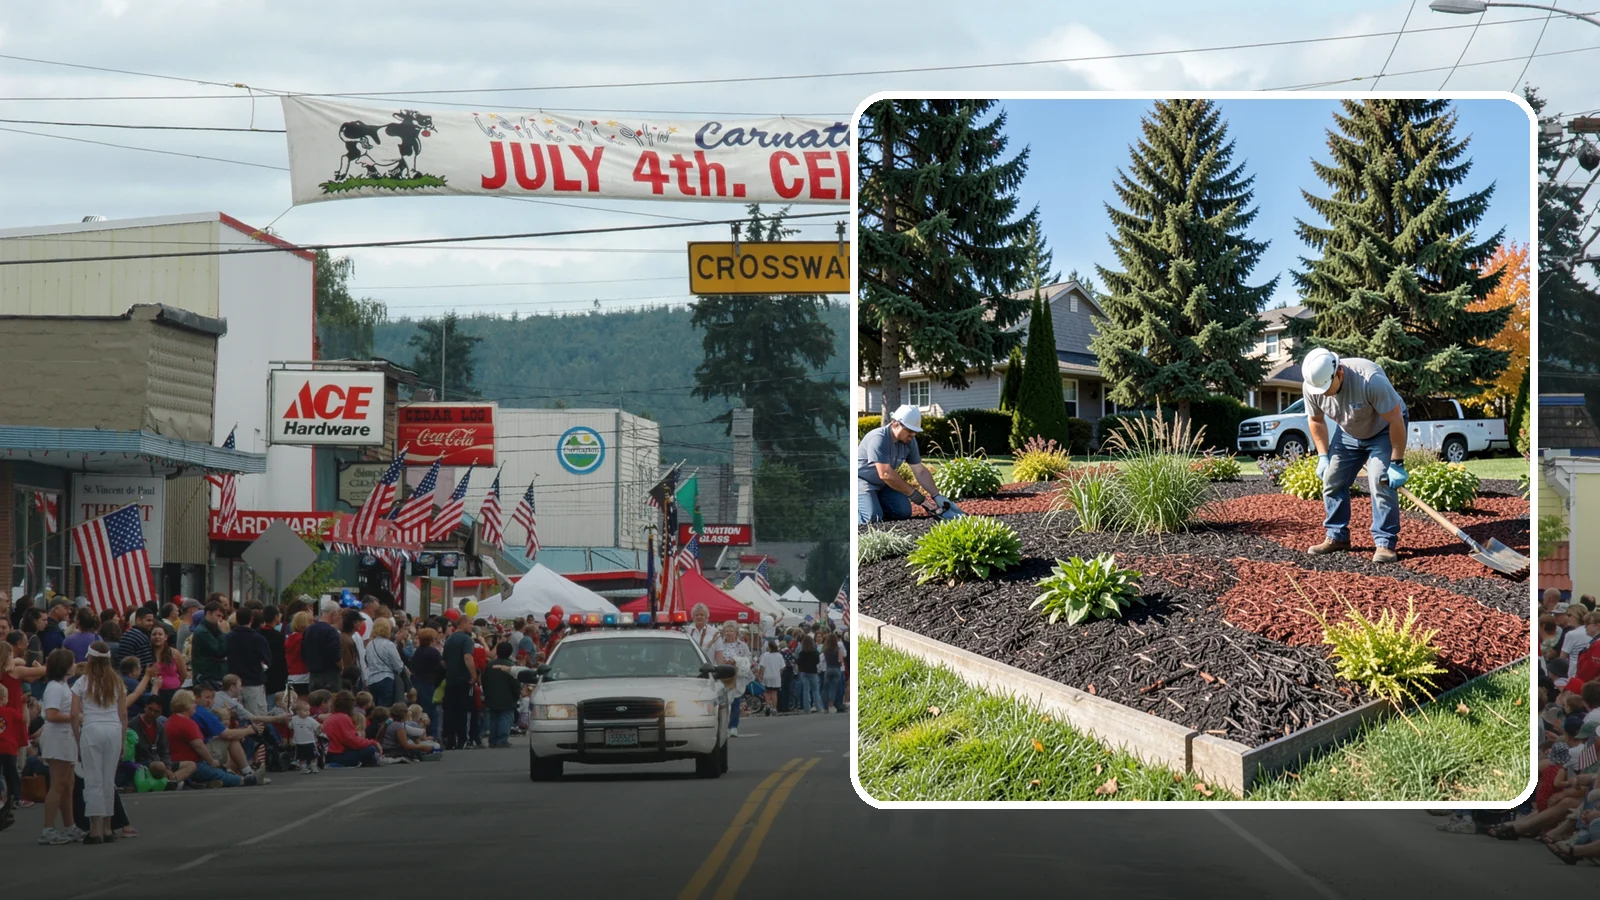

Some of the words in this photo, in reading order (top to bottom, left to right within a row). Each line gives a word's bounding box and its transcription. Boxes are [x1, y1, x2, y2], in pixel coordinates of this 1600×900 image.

[695, 121, 850, 149] Carnat
[481, 141, 604, 193] JULY
[632, 149, 746, 198] 4th.
[697, 254, 850, 280] CROSSWA
[283, 380, 373, 420] ACE
[405, 409, 453, 422] CEDAR
[284, 421, 370, 436] Hardware
[416, 428, 477, 447] Coca-Cola
[83, 484, 94, 494] St.
[96, 484, 124, 494] Vincent
[126, 485, 136, 494] de
[138, 485, 155, 495] Paul
[699, 535, 730, 543] GLASS
